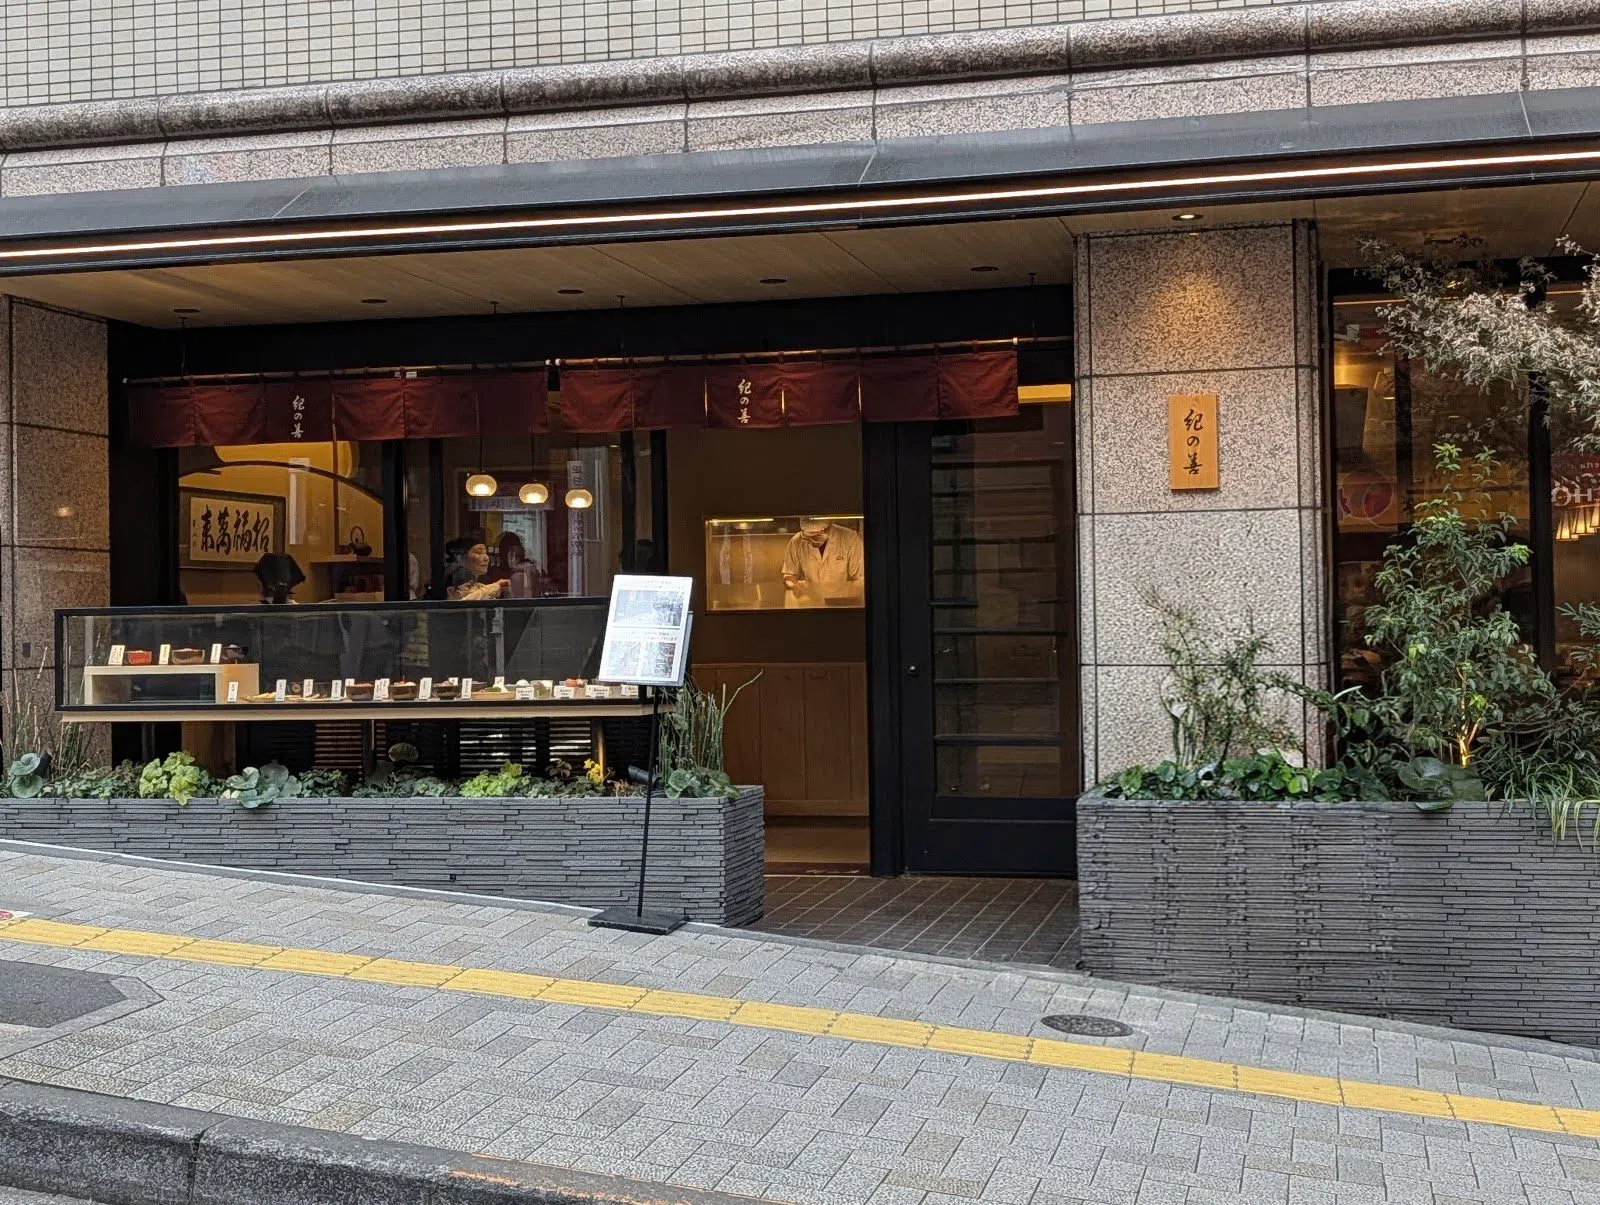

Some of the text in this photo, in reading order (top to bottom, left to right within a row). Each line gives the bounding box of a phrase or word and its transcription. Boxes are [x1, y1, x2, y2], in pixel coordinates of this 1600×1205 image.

[291, 395, 305, 439] 紀の善
[737, 378, 752, 424] 紀の善
[1183, 408, 1204, 475] 紀の善
